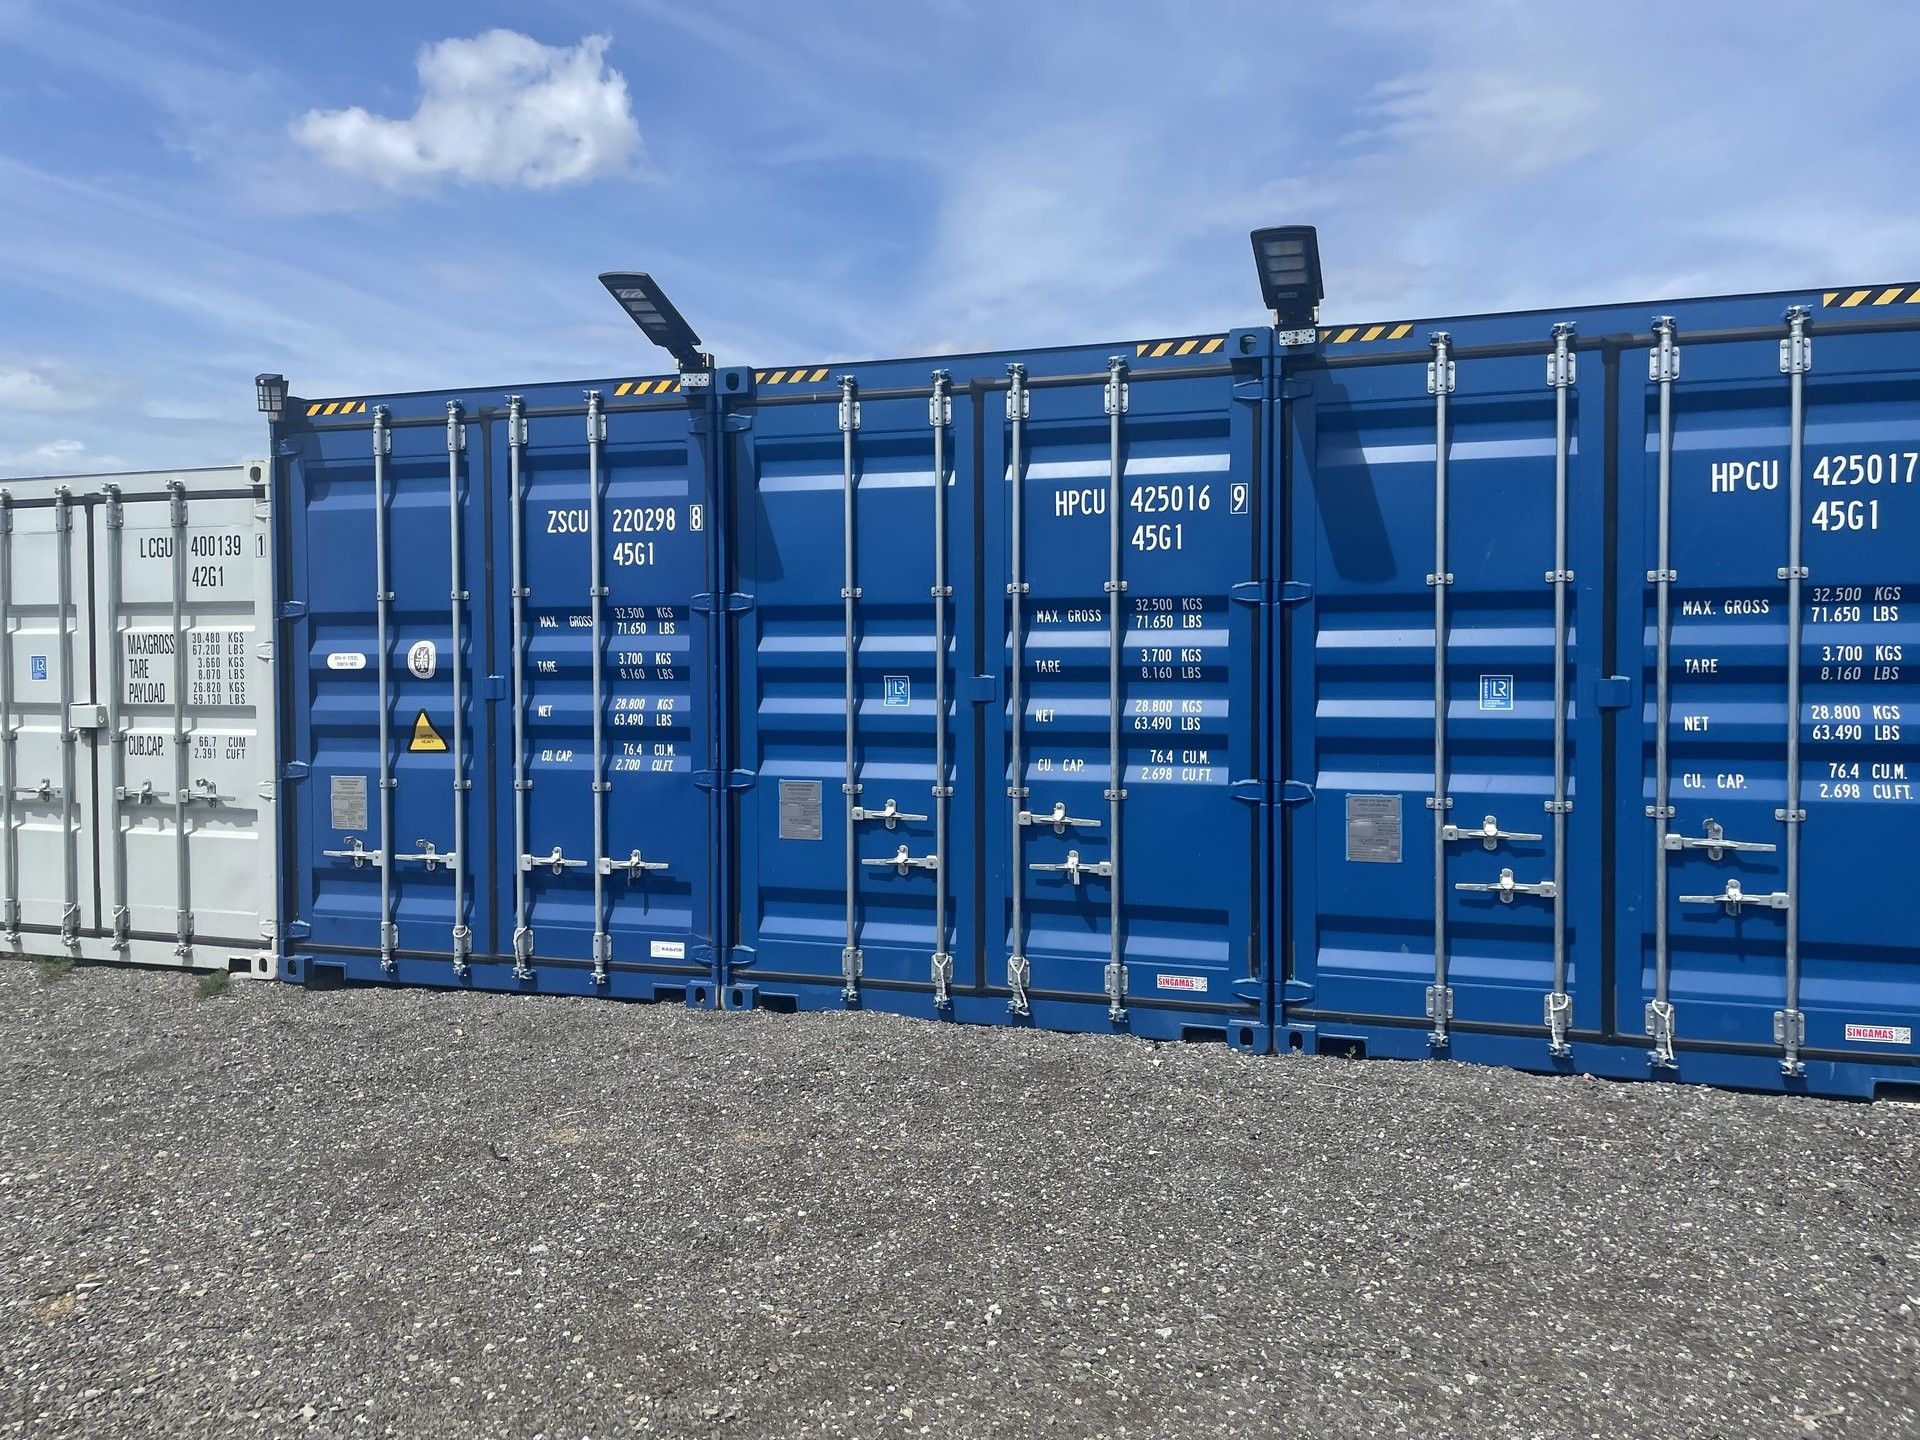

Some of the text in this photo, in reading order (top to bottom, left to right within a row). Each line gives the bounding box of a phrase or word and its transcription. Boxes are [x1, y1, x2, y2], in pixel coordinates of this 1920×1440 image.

[1711, 452, 1918, 493] HPCU 425017
[1055, 484, 1245, 516] HPCU 425016 9
[547, 506, 701, 533] ZSCU 220298 8
[1811, 500, 1878, 531] 45G1
[1132, 524, 1182, 550] 45G1
[140, 537, 173, 558] LCGU
[191, 535, 240, 556] 400139
[613, 542, 654, 566] 45G1
[192, 566, 224, 586] 42G1
[1813, 587, 1902, 601] 32.500 KGS
[1135, 598, 1202, 611] 32.500 KGS
[1682, 600, 1769, 616] MAX. GROSS
[614, 607, 674, 619] 32.500 KGS
[1037, 610, 1102, 623] MAX. GROSS
[1811, 606, 1899, 622] 71.650 LBS
[540, 616, 592, 628] MAX. GROSS
[617, 622, 675, 634] 71.650 LBS
[1137, 615, 1202, 629] 71.650 LBS
[192, 632, 244, 643] 30.480 KGS
[192, 644, 244, 655] 67.200 LBS
[1141, 649, 1202, 662] 3.700 KGS
[1822, 646, 1902, 662] 3.700 KGS
[198, 657, 244, 668] 3.660 KGS
[618, 652, 672, 665] 3.700 KGS
[129, 659, 149, 678] TARE
[538, 661, 558, 672] TARE
[1035, 660, 1061, 673] TARE
[1685, 659, 1718, 673] TARE
[198, 669, 244, 679] 8.070 LBS
[620, 668, 674, 680] 8.160 LBS
[1142, 667, 1201, 679] 8.160 LBS
[1821, 666, 1899, 681] 8.160 LBS
[129, 683, 165, 702] PAYLOAD
[193, 682, 245, 692] 26.820 KGS
[1493, 681, 1506, 696] LR
[193, 694, 245, 704] 59.130 LBS
[615, 698, 674, 710] 28.800 KGS
[538, 705, 552, 717] NET
[1135, 700, 1202, 713] 28.800 KGS
[1811, 705, 1900, 720] 28.800 KGS
[614, 714, 672, 726] 63.490 LBS
[1035, 709, 1055, 722] NET
[1134, 717, 1200, 730] 63.490 LBS
[1684, 716, 1709, 732] NET
[1812, 725, 1900, 741] 63.490 LBS
[129, 736, 164, 756] CUB.CAP.
[199, 737, 246, 747] 66.7 CUM
[195, 748, 246, 759] 2.391 CUFT
[542, 750, 573, 762] CU. CAP.
[624, 743, 676, 756] 76.4 CU.M.
[1151, 750, 1210, 764] 76.4 CU.M.
[616, 759, 673, 772] 2.700 CU.FT.
[1037, 759, 1085, 772] CU. CAP.
[1829, 763, 1908, 780] 76.4 CU.M.
[1142, 768, 1212, 781] 2.698 CU.FT.
[1683, 774, 1747, 789] CU. CAP.
[1819, 783, 1913, 800] 2.698 CU.FT.
[1158, 978, 1194, 988] SINGAMAS
[1847, 1028, 1894, 1039] SINGAMAS
